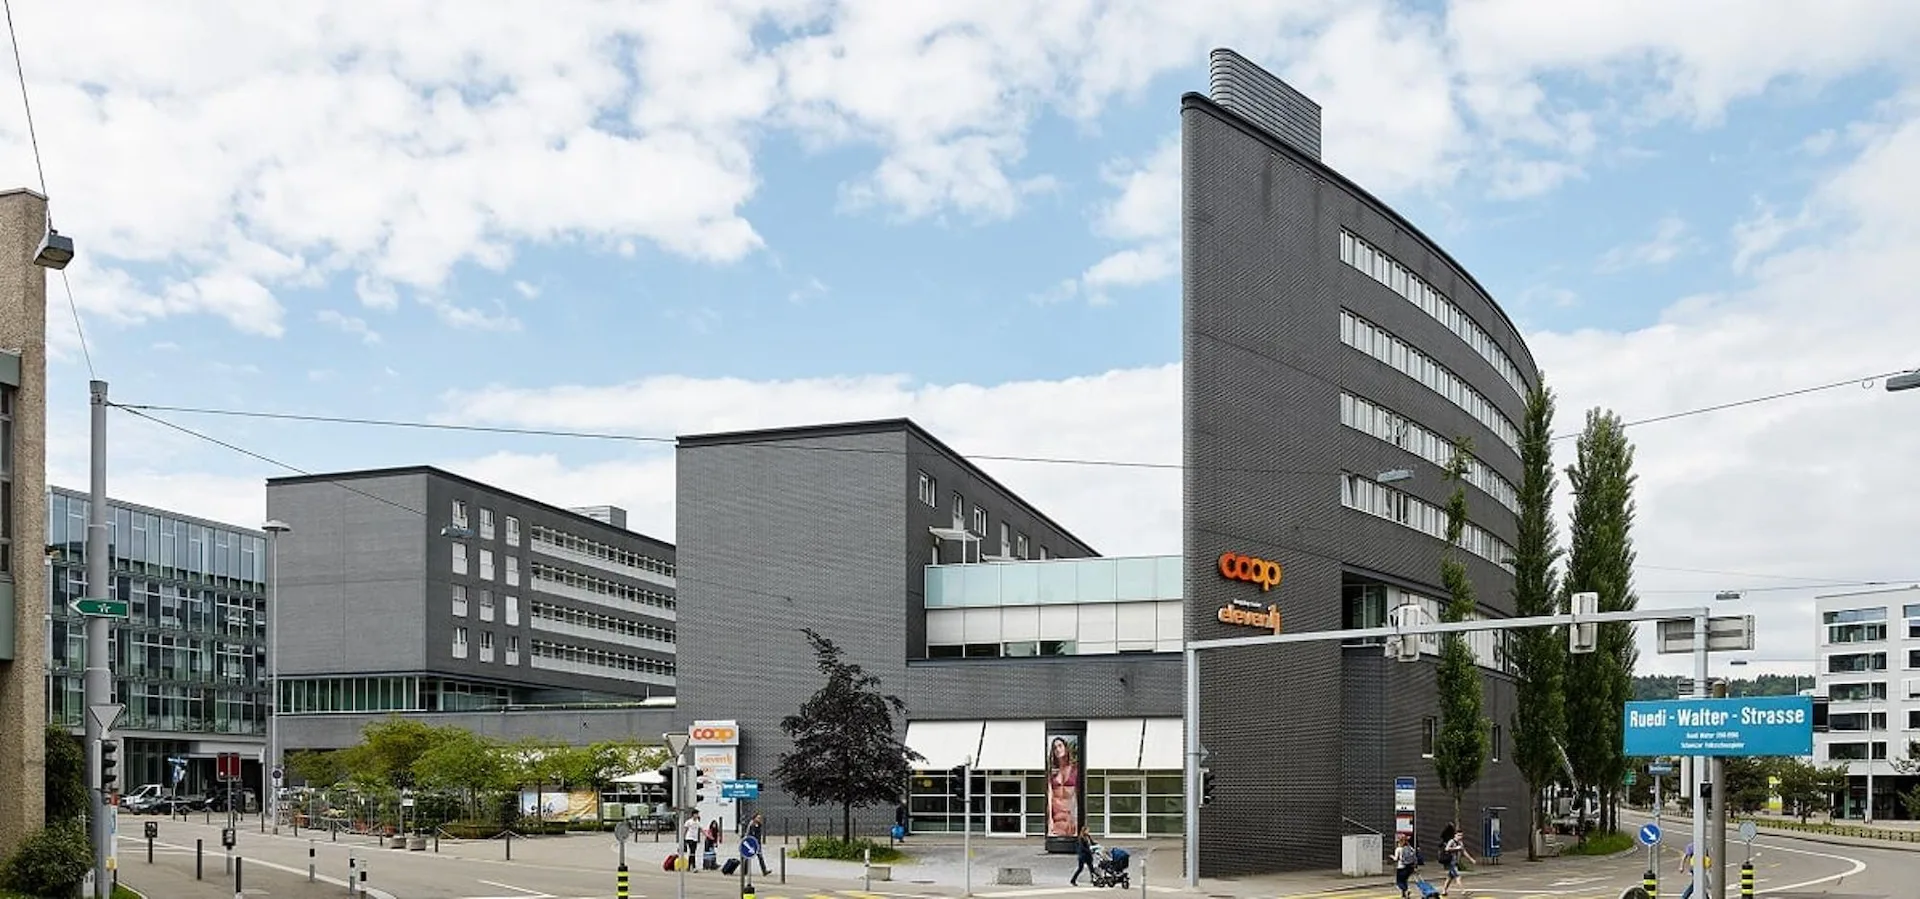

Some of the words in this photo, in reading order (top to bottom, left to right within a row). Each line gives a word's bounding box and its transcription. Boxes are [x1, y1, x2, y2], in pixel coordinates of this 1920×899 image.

[1219, 551, 1283, 591] coop
[1630, 709, 1667, 728] Ruedi
[1677, 708, 1729, 727] Walter
[1741, 706, 1805, 725] Strasse
[693, 728, 734, 743] coop
